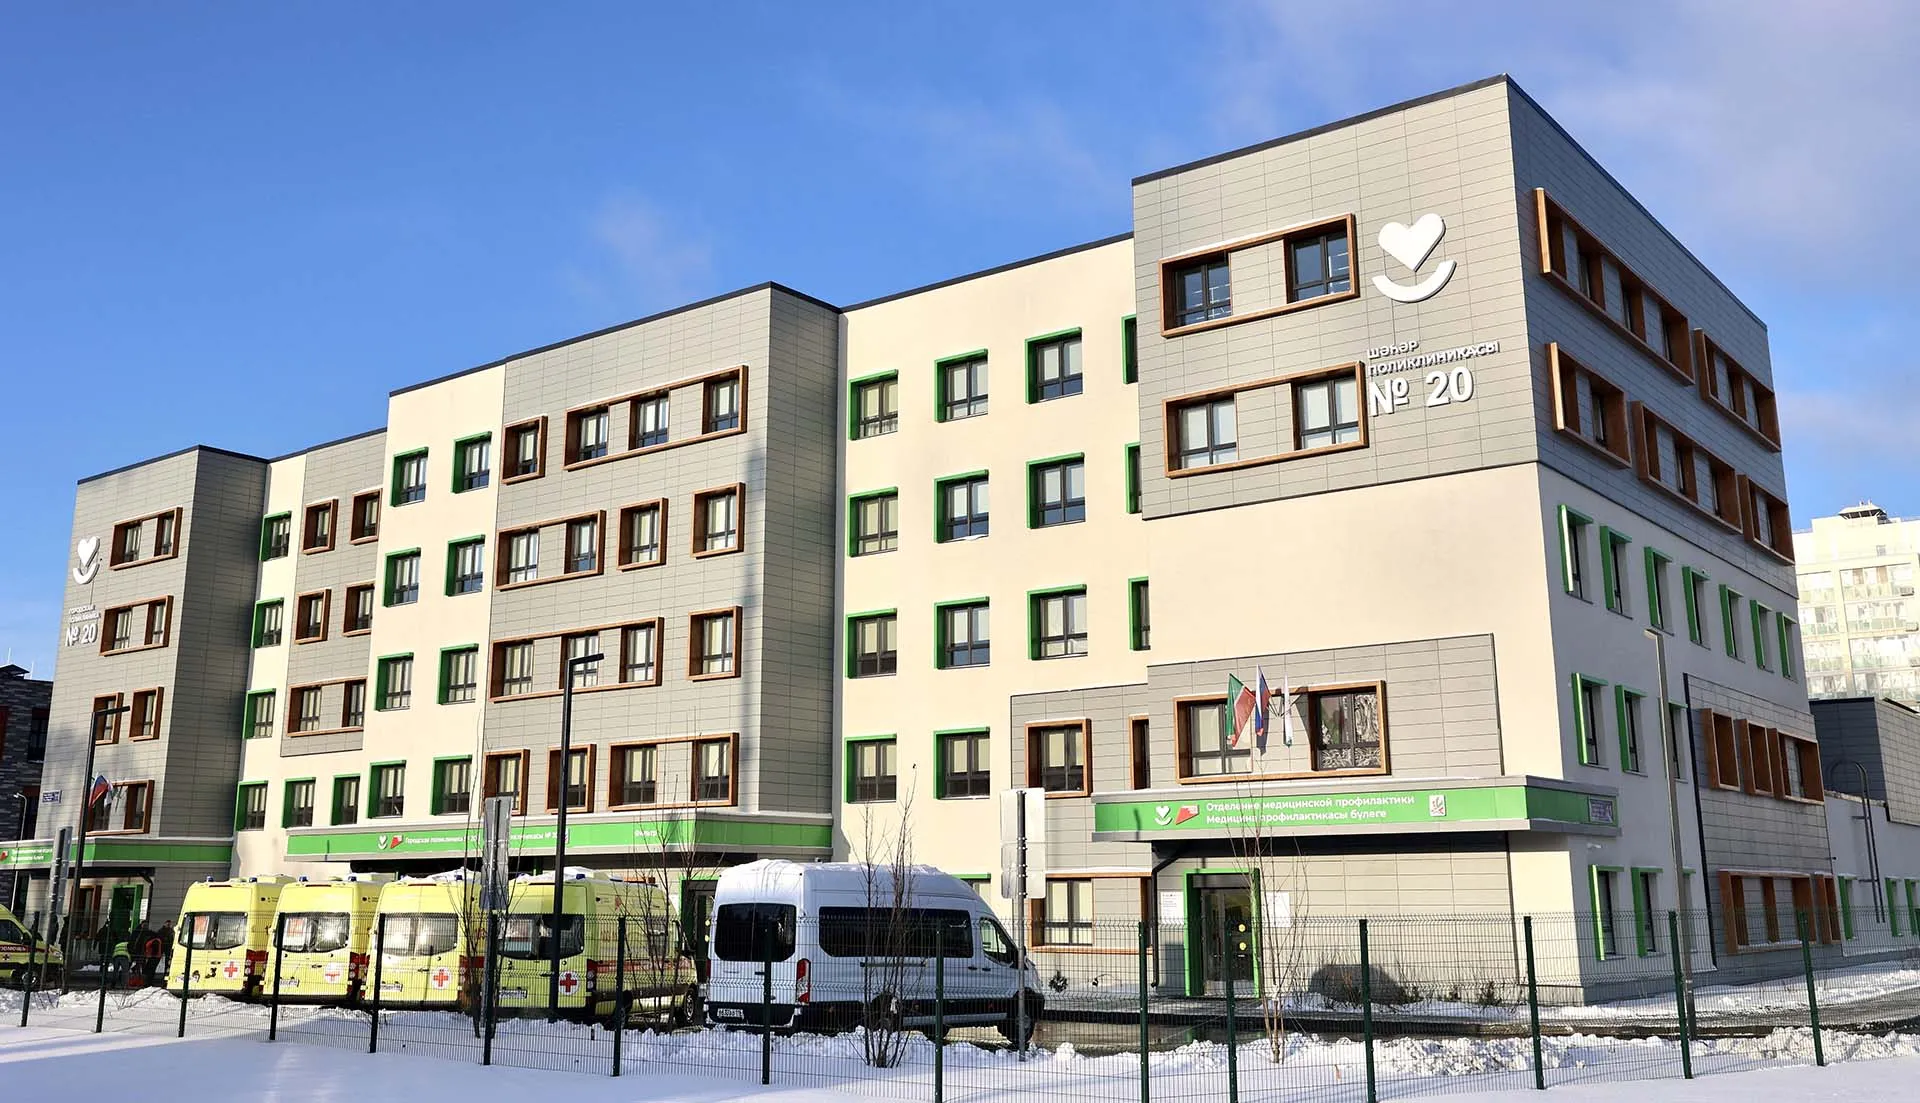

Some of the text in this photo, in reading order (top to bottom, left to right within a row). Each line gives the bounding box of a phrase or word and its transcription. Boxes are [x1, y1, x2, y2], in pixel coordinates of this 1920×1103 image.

[1367, 340, 1501, 377] ПОЛИКЛИНИКАСЫ
[1369, 365, 1474, 417] № 20
[65, 624, 98, 647] № 20
[1206, 801, 1260, 812] Отделение
[1262, 797, 1332, 811] медицинской
[1335, 795, 1415, 809] профилактики
